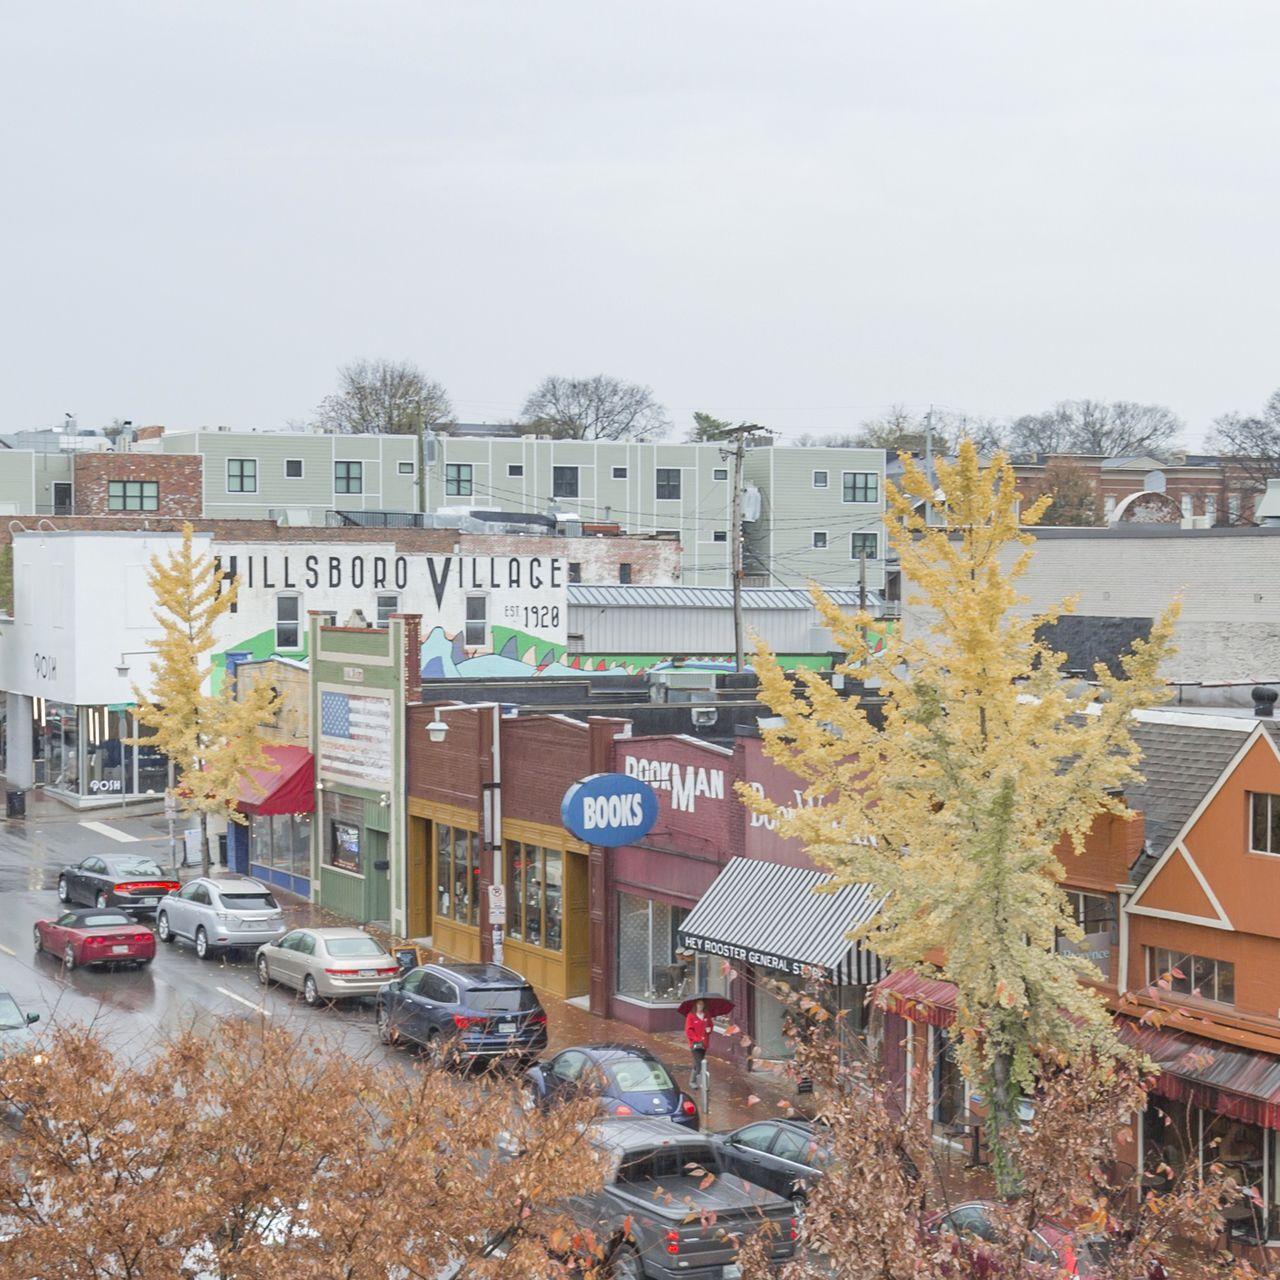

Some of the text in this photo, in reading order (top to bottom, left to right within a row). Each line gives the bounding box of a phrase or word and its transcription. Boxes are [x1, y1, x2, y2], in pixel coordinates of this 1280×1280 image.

[214, 554, 561, 613] HILLSBORO VILLAGE
[524, 605, 559, 628] 1920
[90, 780, 121, 791] POSH
[583, 792, 643, 830] BOOKS
[685, 936, 705, 949] HEY
[704, 940, 747, 961] ROOSTER
[748, 951, 790, 972] GENERAL
